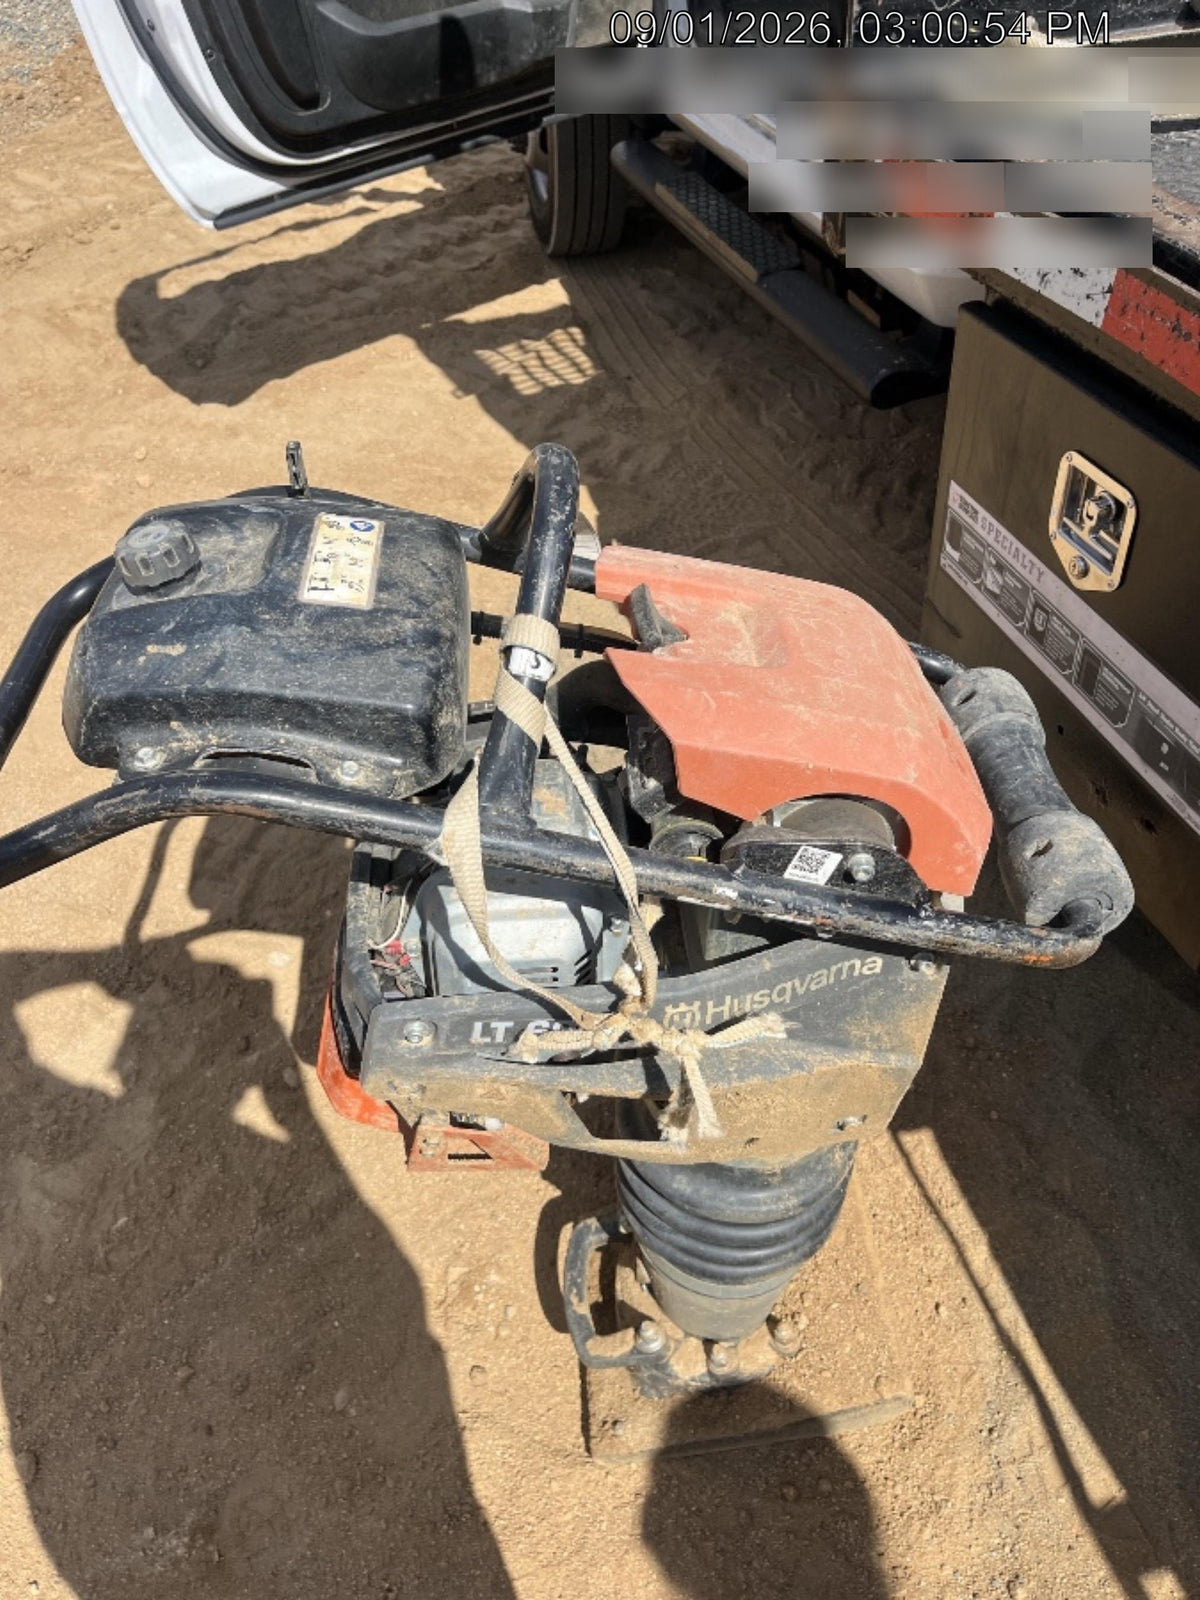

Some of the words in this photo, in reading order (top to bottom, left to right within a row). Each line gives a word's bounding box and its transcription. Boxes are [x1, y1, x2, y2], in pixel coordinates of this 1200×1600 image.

[980, 516, 1044, 582] SPECIALTY
[705, 955, 883, 1025] Husqvarna
[470, 1021, 514, 1043] LT
